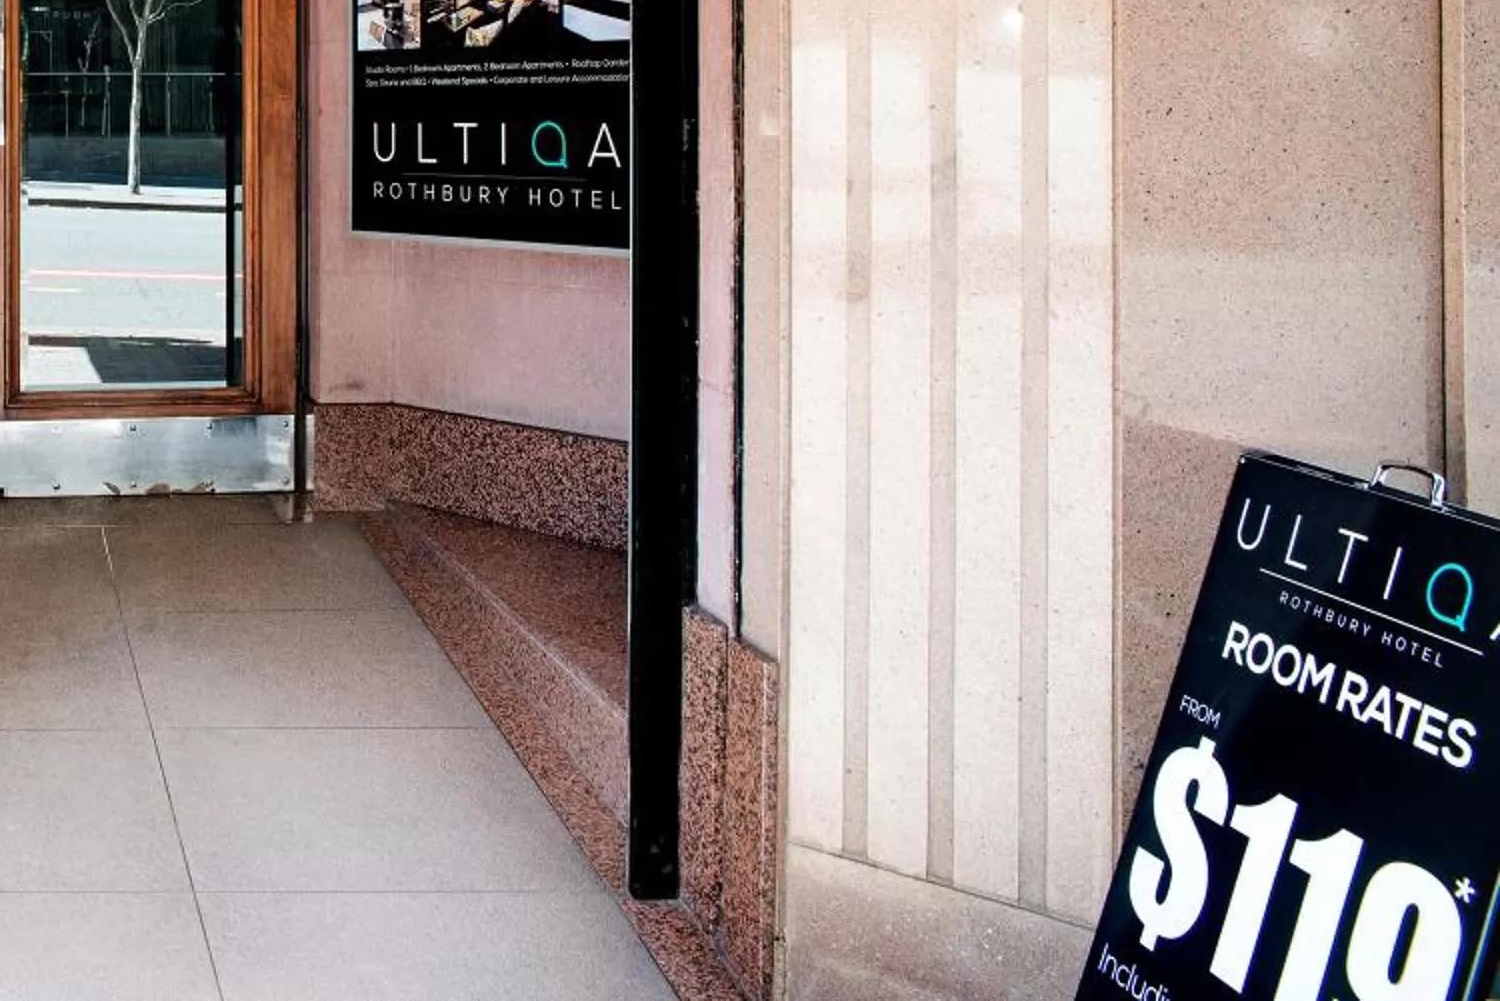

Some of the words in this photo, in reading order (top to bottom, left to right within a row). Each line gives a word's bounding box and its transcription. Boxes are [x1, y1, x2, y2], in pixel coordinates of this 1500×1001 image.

[373, 120, 622, 168] ULTIQA
[373, 181, 509, 205] ROTHBURY
[528, 187, 622, 210] HOTEL
[1236, 498, 1500, 642] ULTIQ
[1279, 591, 1372, 637] ROTHBURY
[1381, 630, 1444, 669] HOTEL
[1179, 694, 1221, 730] FROM
[1221, 620, 1337, 705] ROOM
[1335, 670, 1477, 769] RATES
